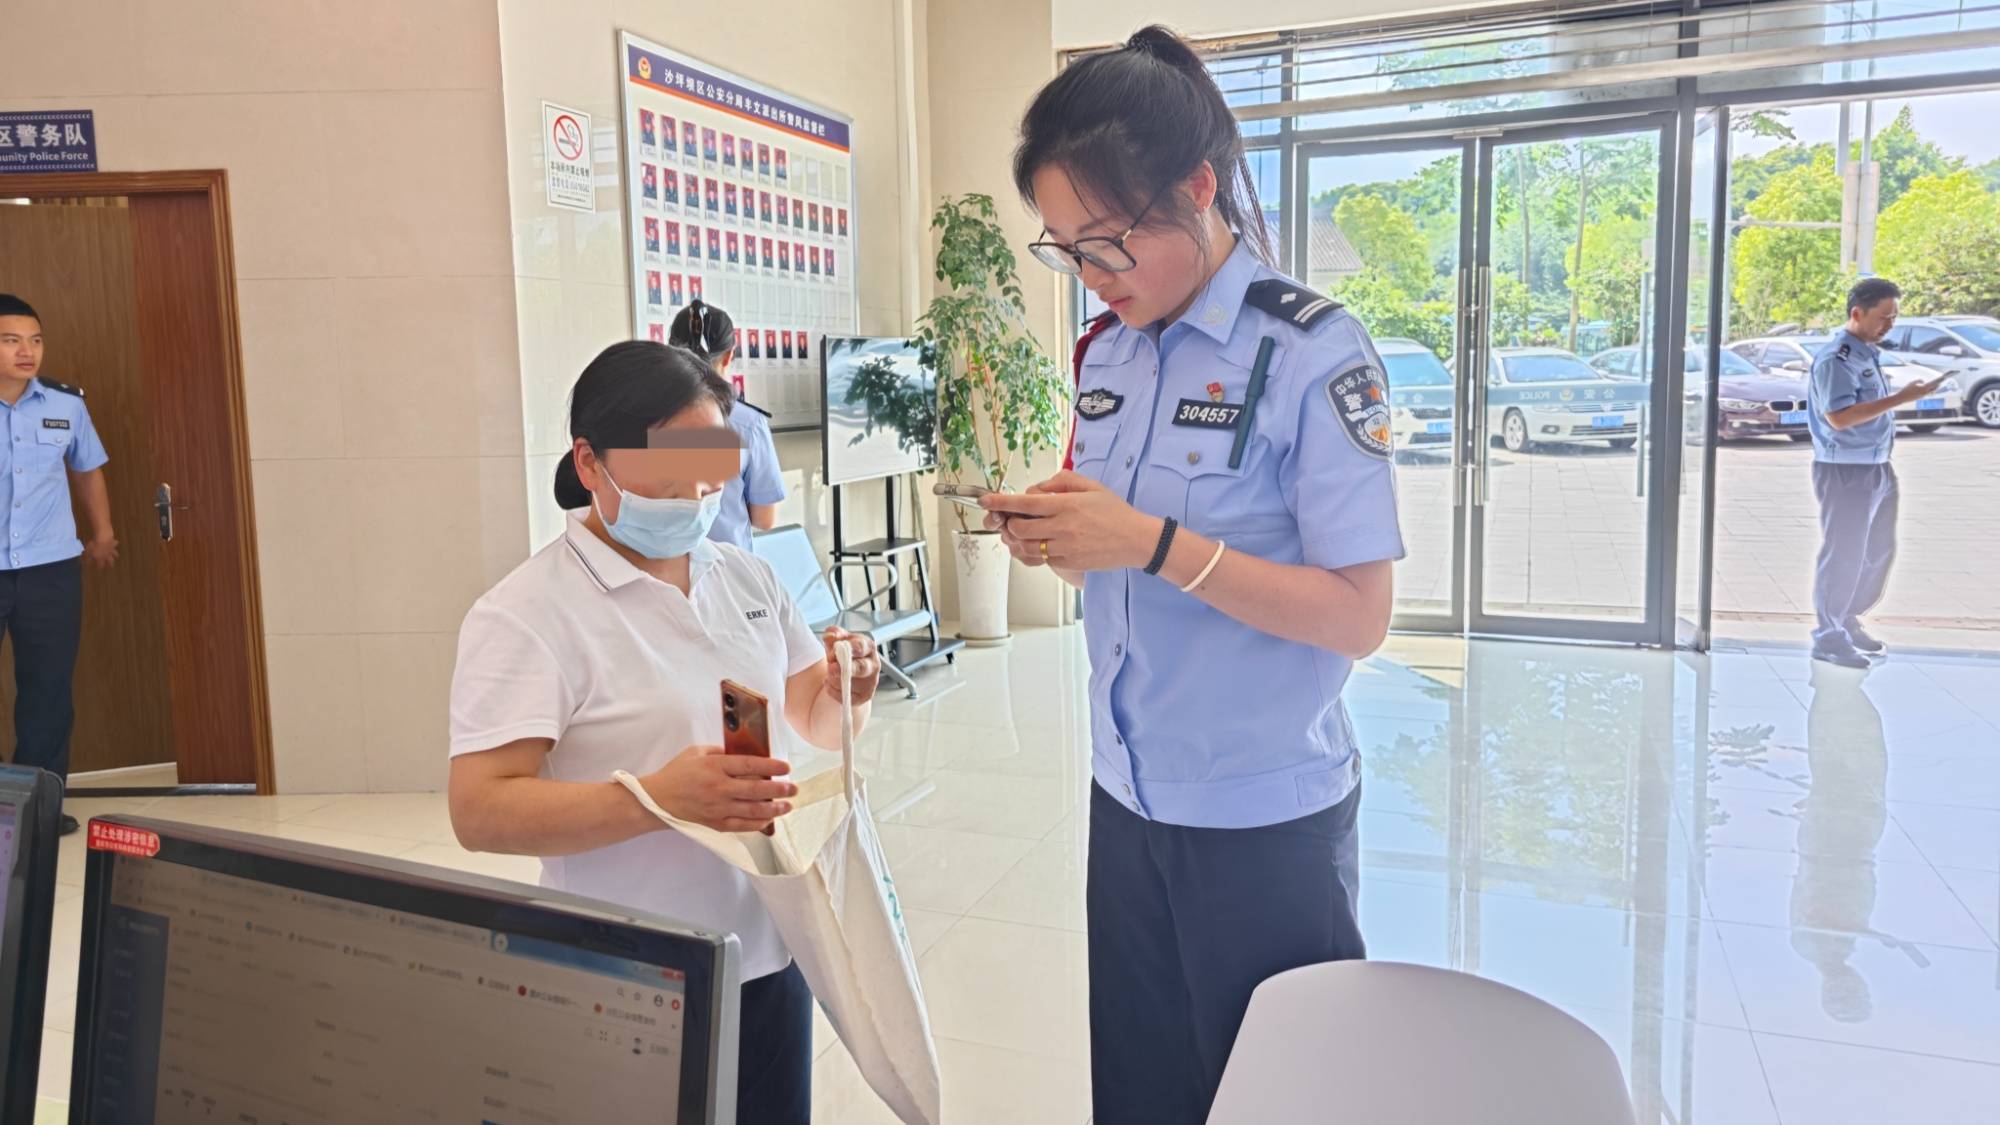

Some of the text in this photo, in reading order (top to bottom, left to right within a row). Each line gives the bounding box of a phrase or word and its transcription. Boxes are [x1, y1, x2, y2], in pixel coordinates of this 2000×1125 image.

[0, 123, 87, 147] 区警务队
[0, 151, 88, 163] unity Police Force
[1178, 404, 1240, 424] 304557
[745, 608, 769, 620] ERKE
